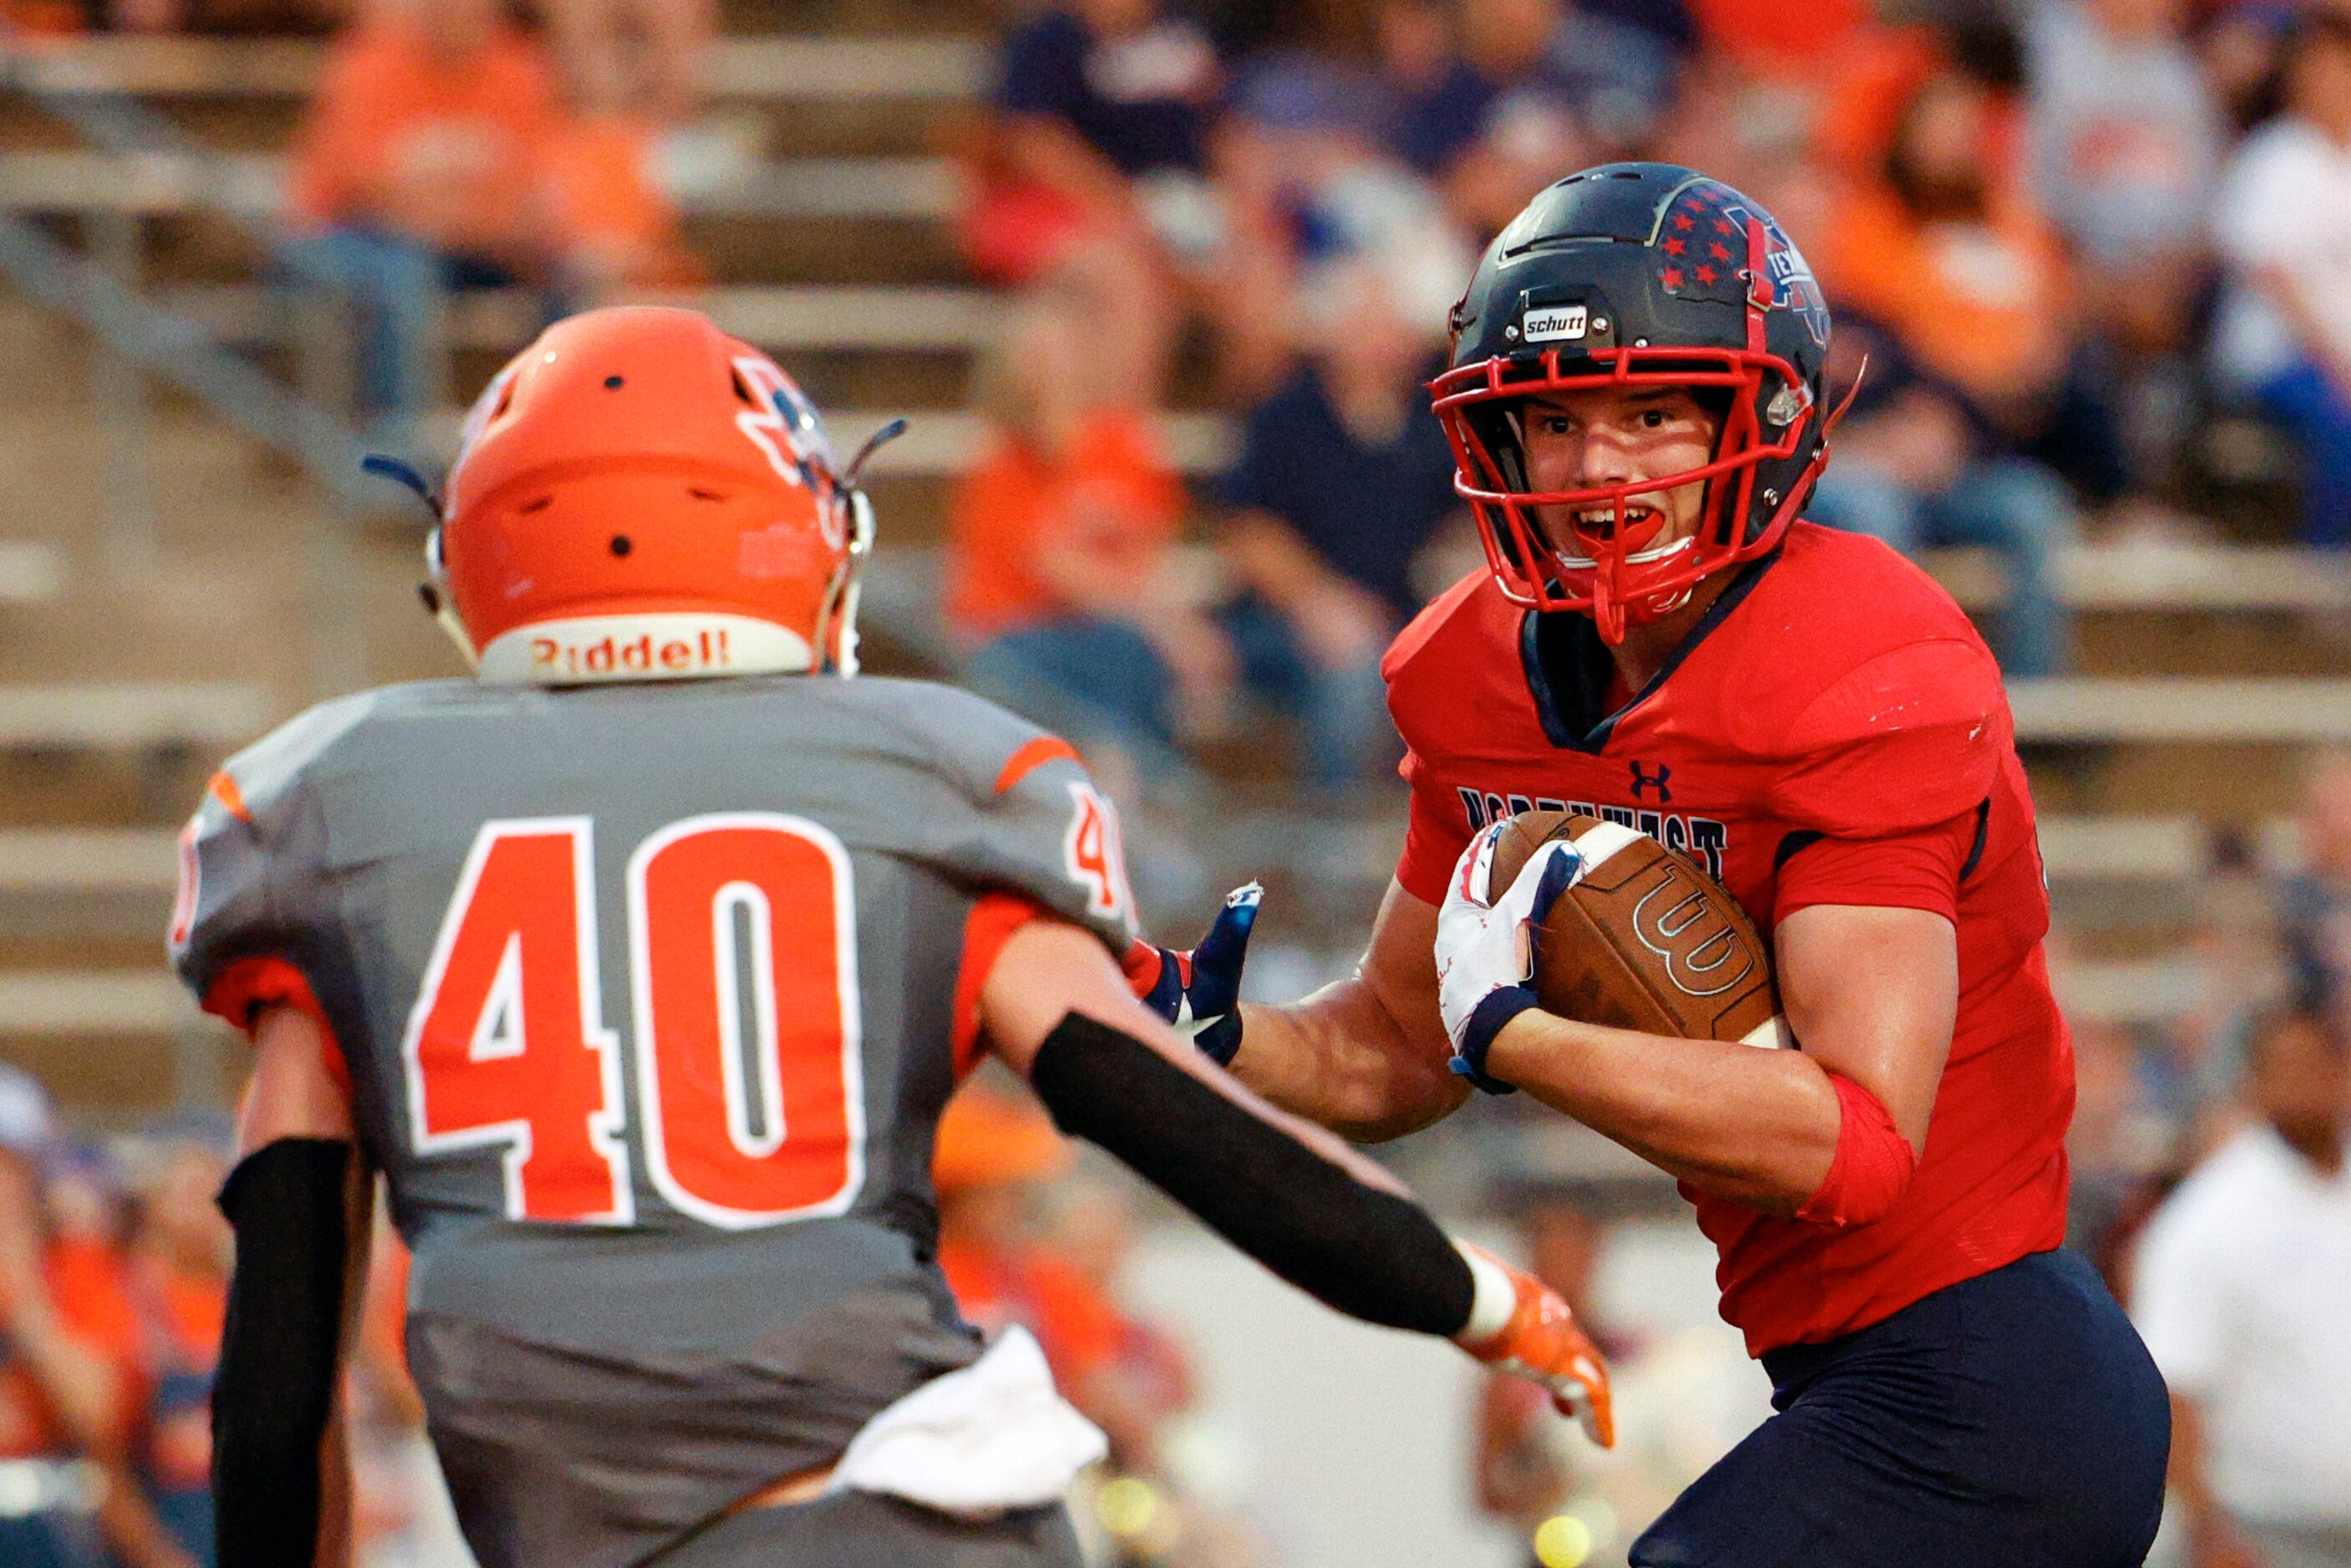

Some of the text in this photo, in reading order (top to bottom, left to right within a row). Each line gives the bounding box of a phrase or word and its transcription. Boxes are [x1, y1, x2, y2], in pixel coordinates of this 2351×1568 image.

[1527, 315, 1584, 334] schutt
[530, 628, 730, 673] Riddell
[1457, 787, 1728, 887] NOEST
[402, 811, 866, 1229] 40
